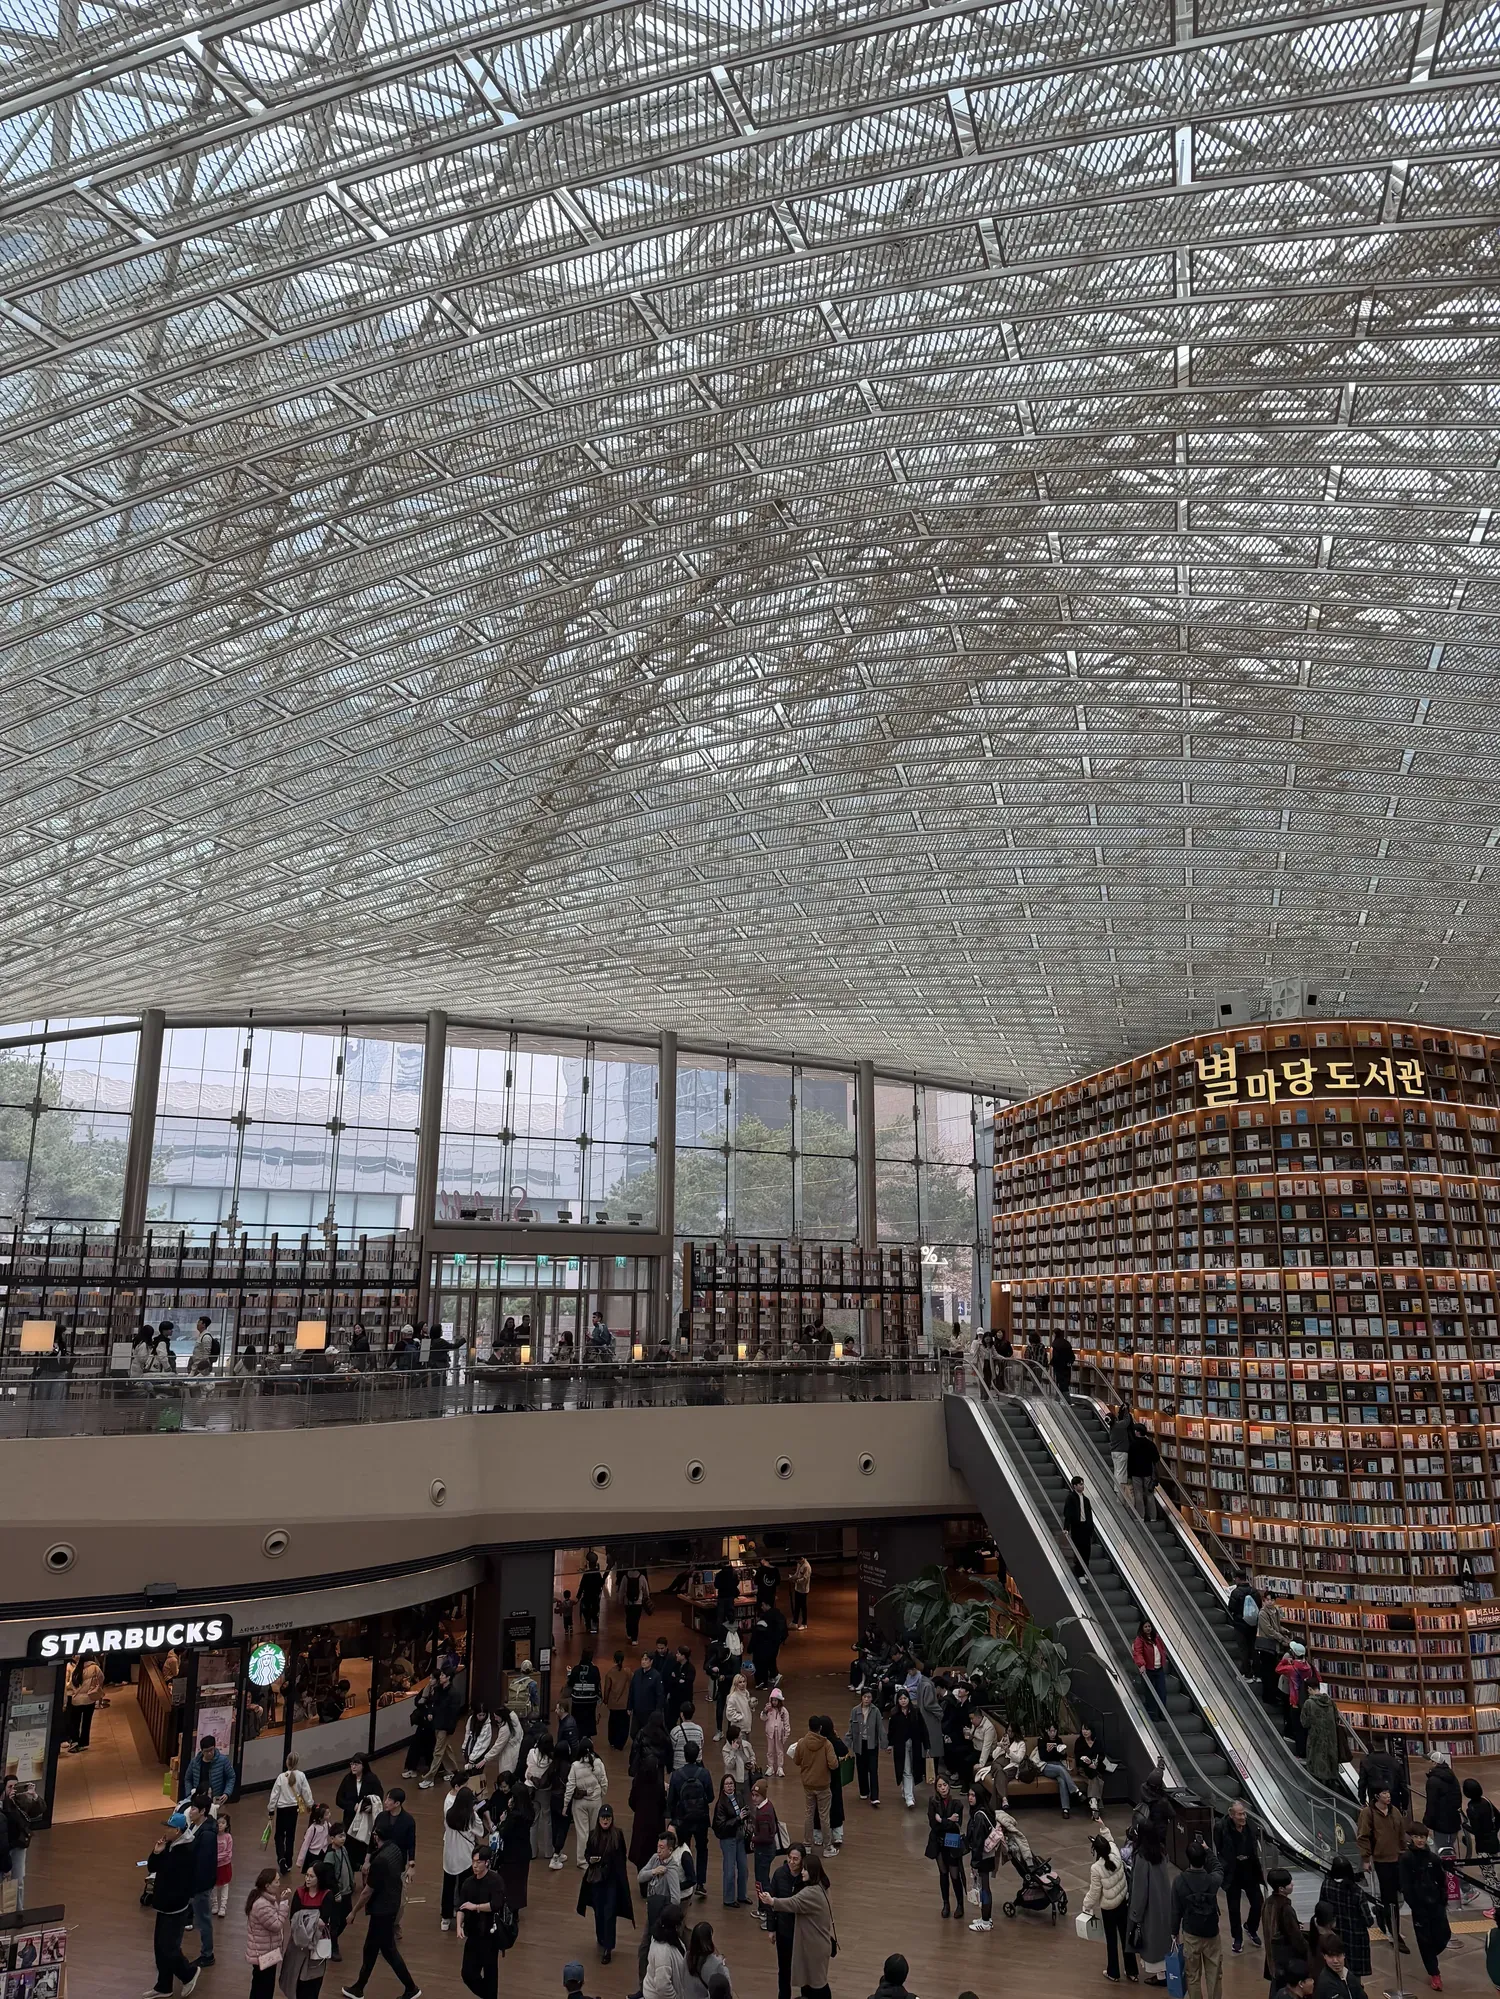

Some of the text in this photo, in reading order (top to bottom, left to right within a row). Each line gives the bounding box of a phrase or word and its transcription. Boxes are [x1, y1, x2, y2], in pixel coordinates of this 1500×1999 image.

[1195, 1047, 1425, 1107] 별마당 도서관
[1462, 1558, 1472, 1575] A
[39, 1619, 223, 1658] STARBUCKS
